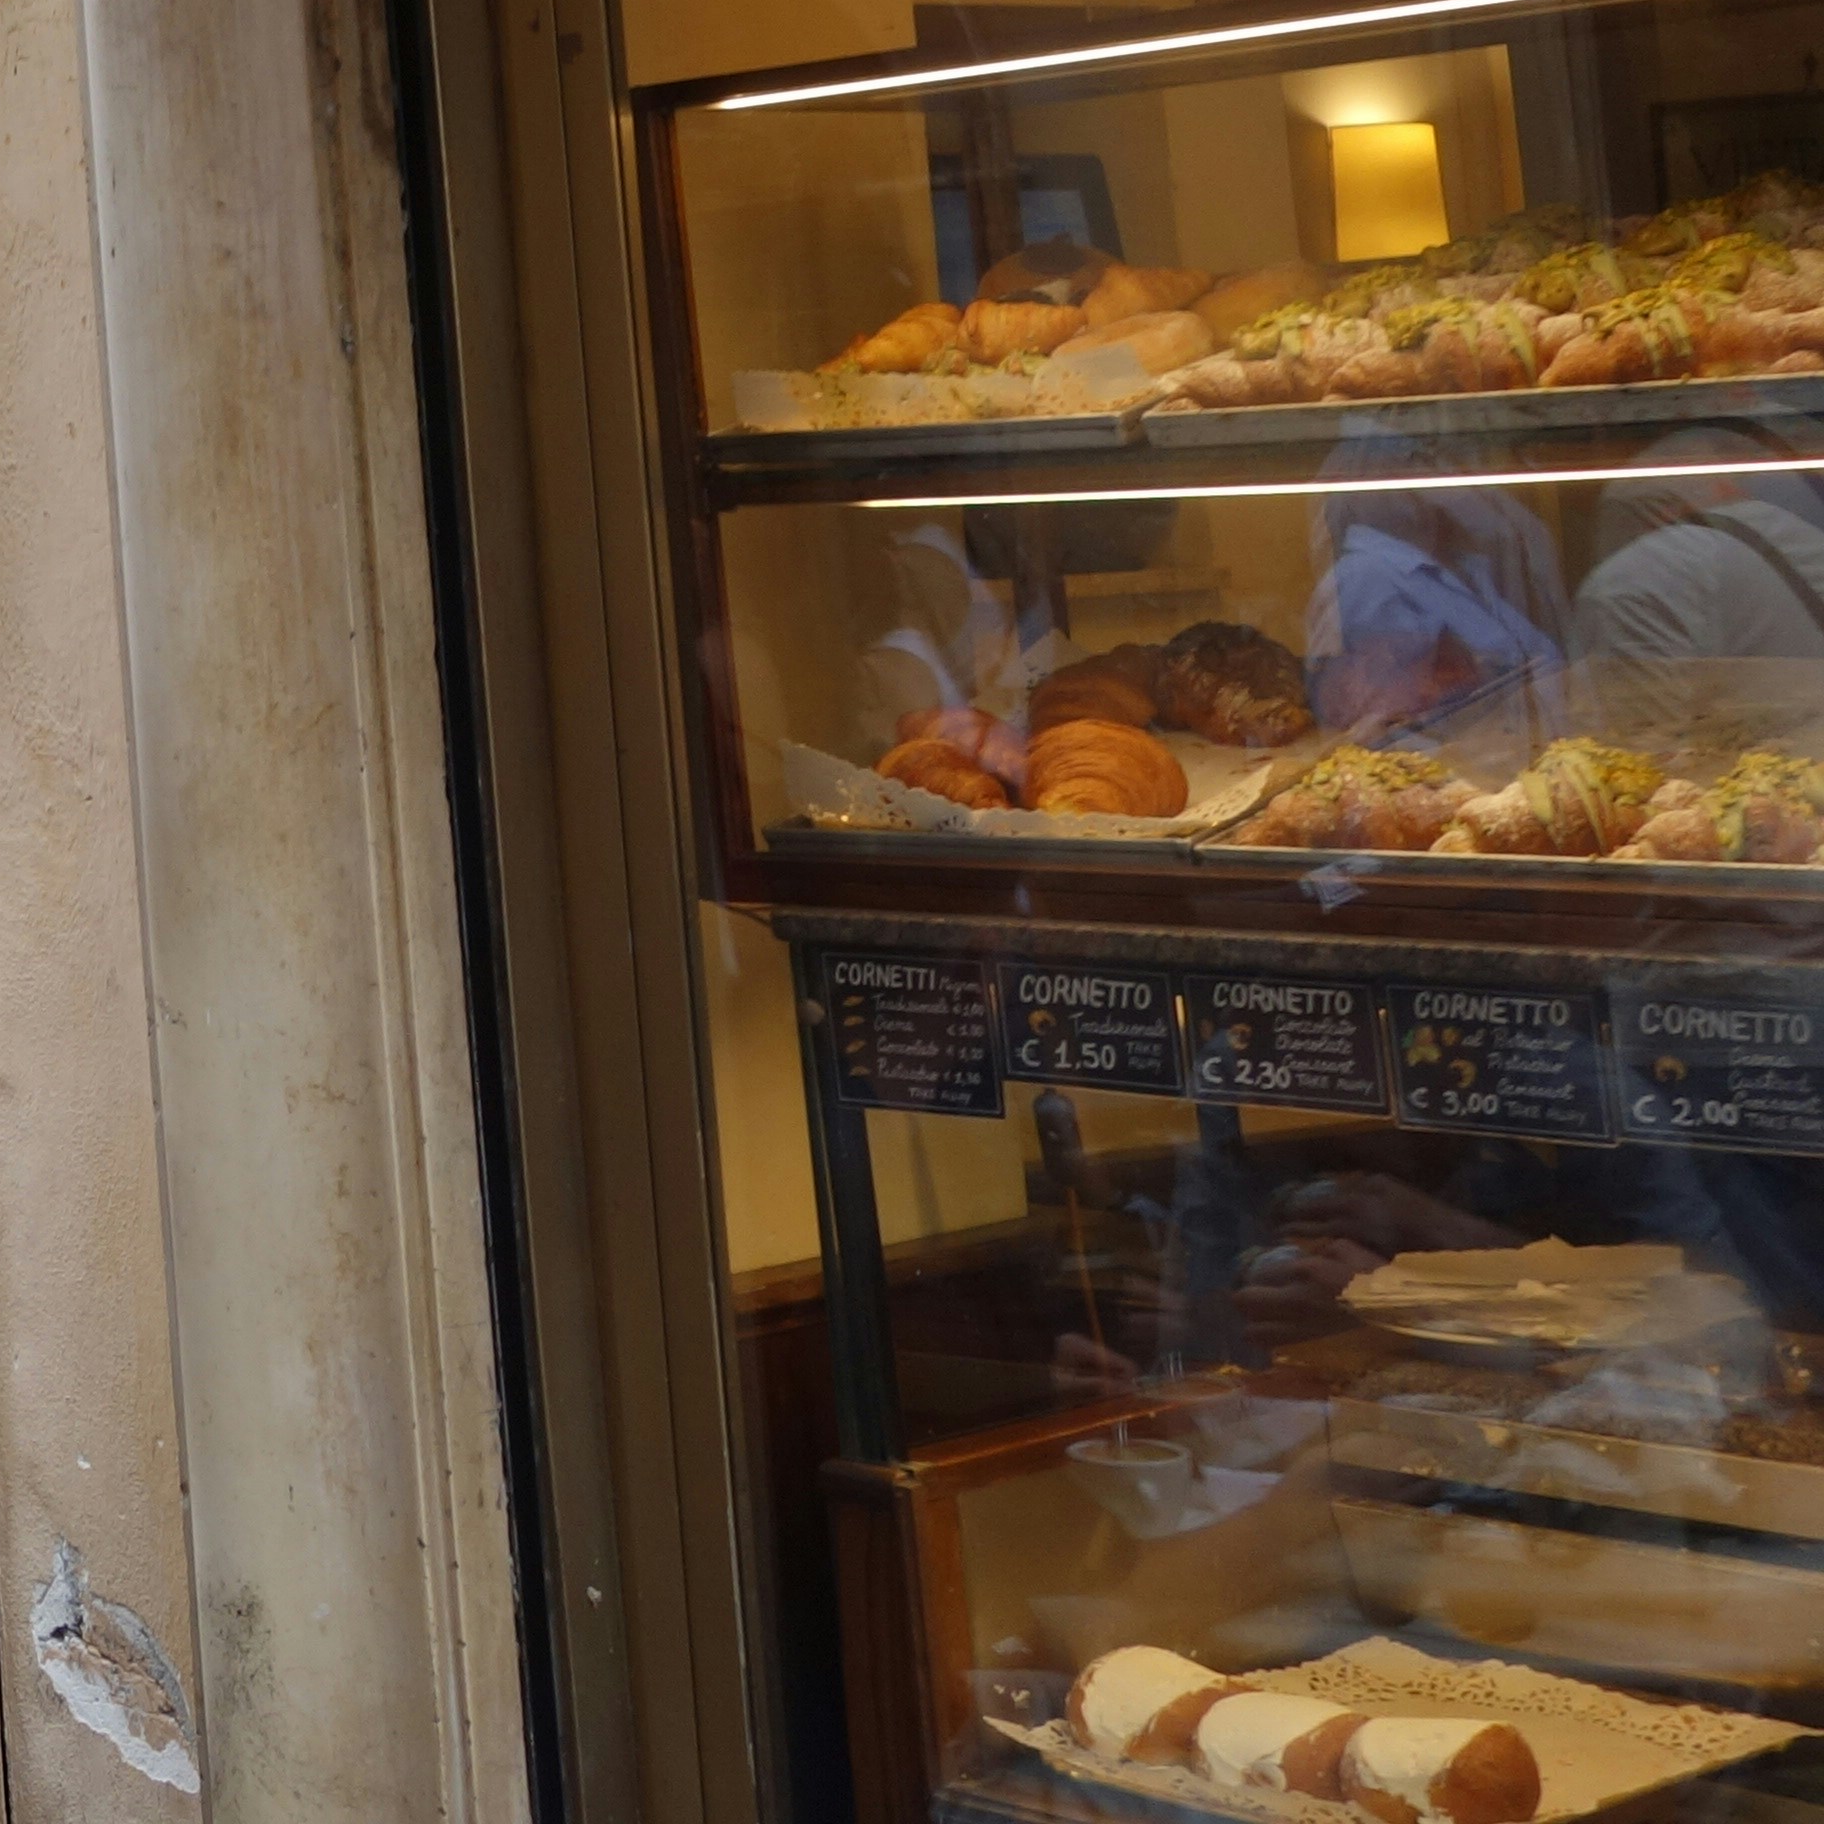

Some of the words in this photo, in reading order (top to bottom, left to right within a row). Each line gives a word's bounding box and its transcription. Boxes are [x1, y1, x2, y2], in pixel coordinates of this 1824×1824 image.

[835, 962, 936, 991] CORNETTI
[1019, 973, 1152, 1010] CORNETTO
[1213, 982, 1354, 1015] CORNETTO
[1413, 991, 1570, 1026] CORNETTO
[1639, 1002, 1811, 1045] CORNETTO
[1054, 1039, 1116, 1070] 1,50
[1233, 1058, 1292, 1090] 2,30
[1441, 1089, 1499, 1116] 3,00
